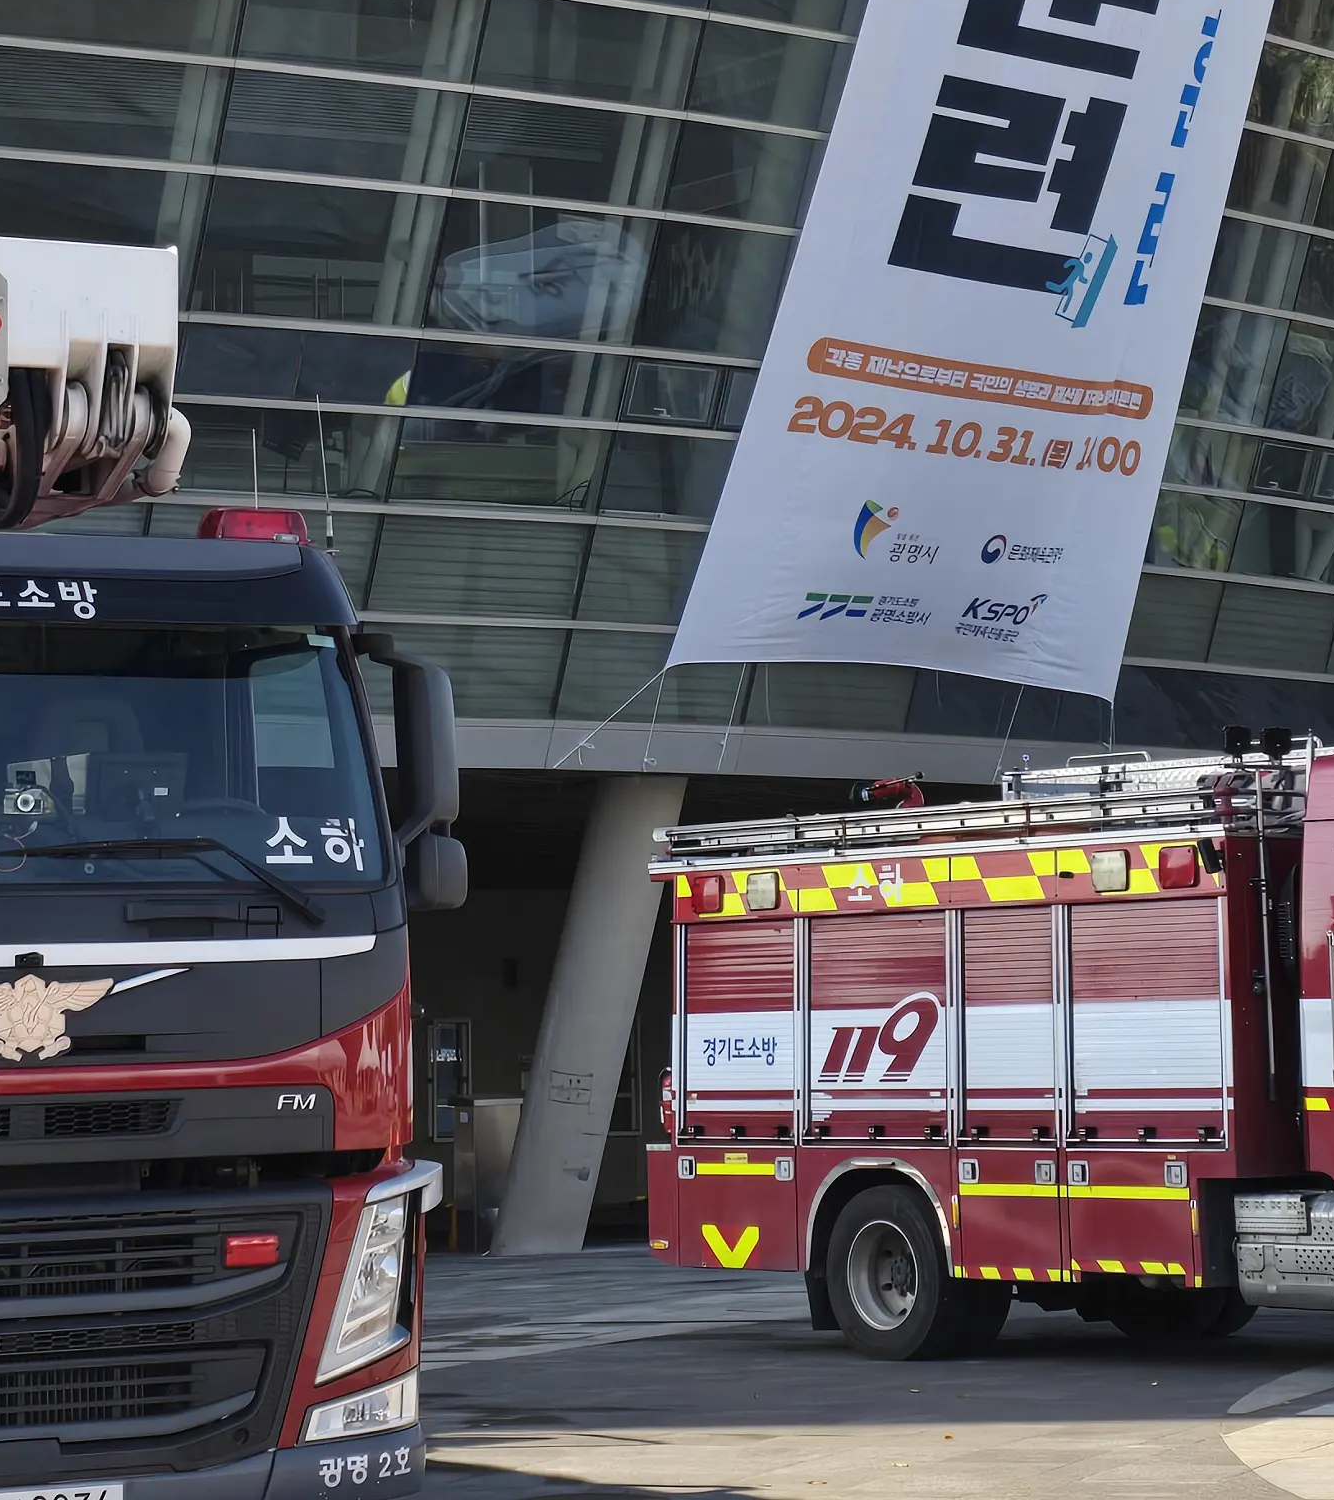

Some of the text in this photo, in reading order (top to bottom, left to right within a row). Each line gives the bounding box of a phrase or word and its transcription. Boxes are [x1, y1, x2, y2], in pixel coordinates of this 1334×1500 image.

[825, 348, 864, 371] 각종
[787, 396, 917, 451] 2024.
[925, 419, 982, 458] 10.
[987, 426, 1036, 466] 31.
[889, 543, 940, 566] 광명시
[961, 597, 1030, 625] KSPO
[265, 816, 366, 872] 소하
[847, 862, 904, 903] 소하
[703, 1036, 777, 1067] 경기도소방
[817, 997, 940, 1082] 119
[277, 1093, 317, 1110] FM
[318, 1446, 412, 1488] 광명 2호
